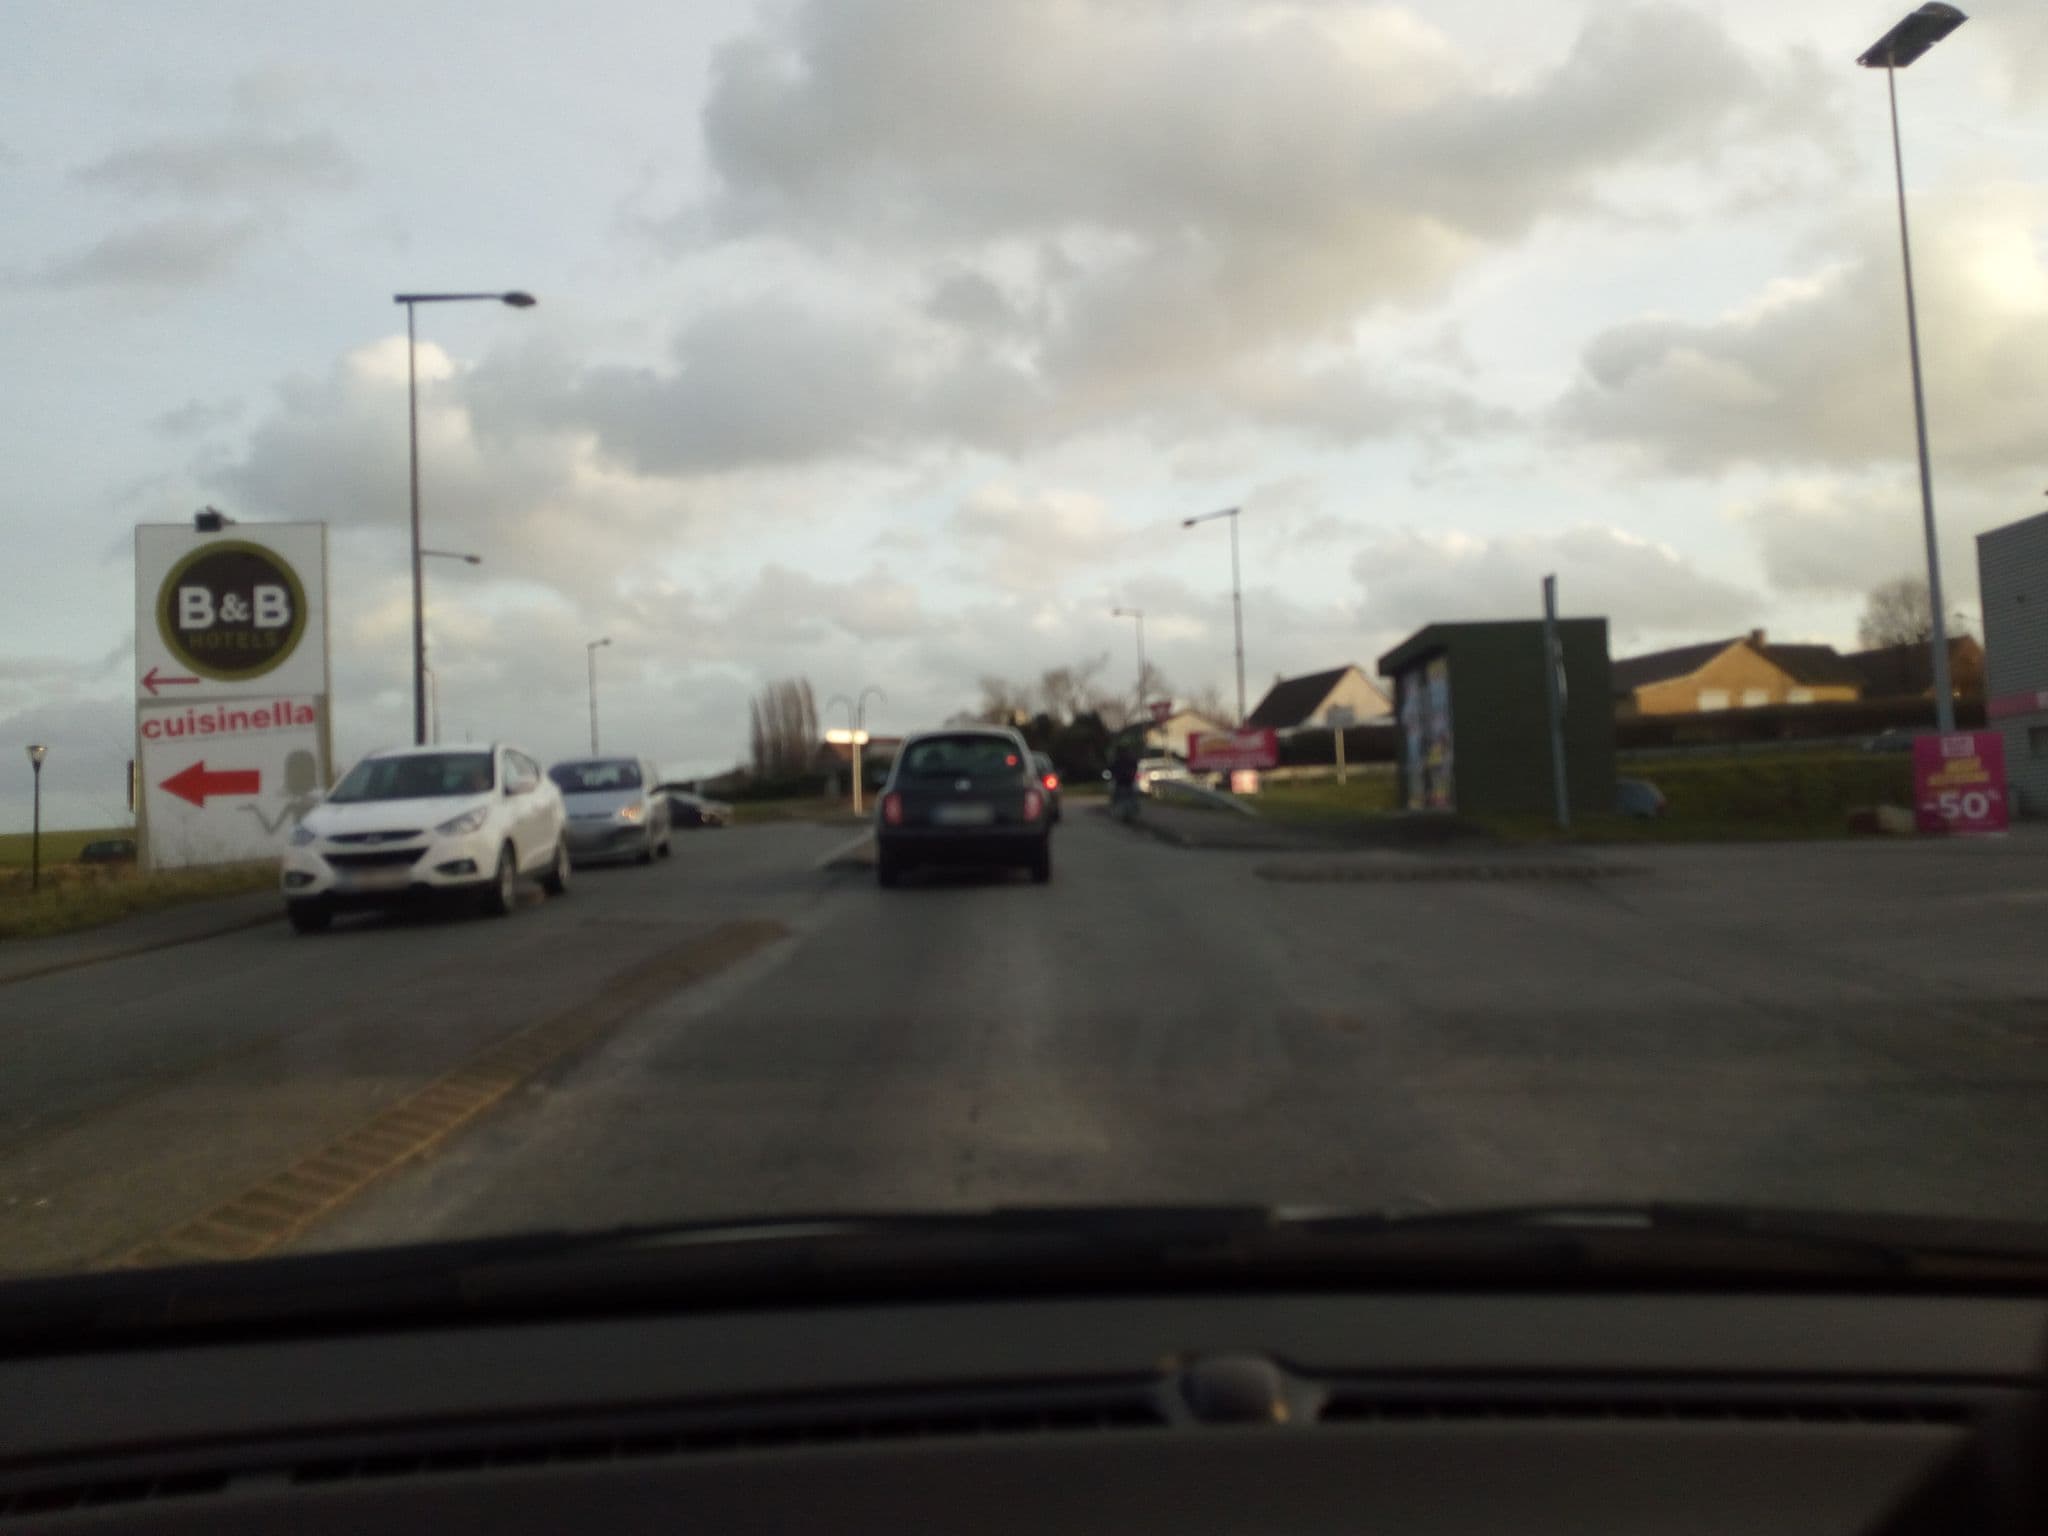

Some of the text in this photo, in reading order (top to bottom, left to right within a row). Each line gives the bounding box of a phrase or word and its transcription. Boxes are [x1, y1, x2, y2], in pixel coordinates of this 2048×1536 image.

[178, 585, 291, 630] B&B
[188, 632, 280, 648] HOTELS
[141, 701, 316, 741] cuisinella
